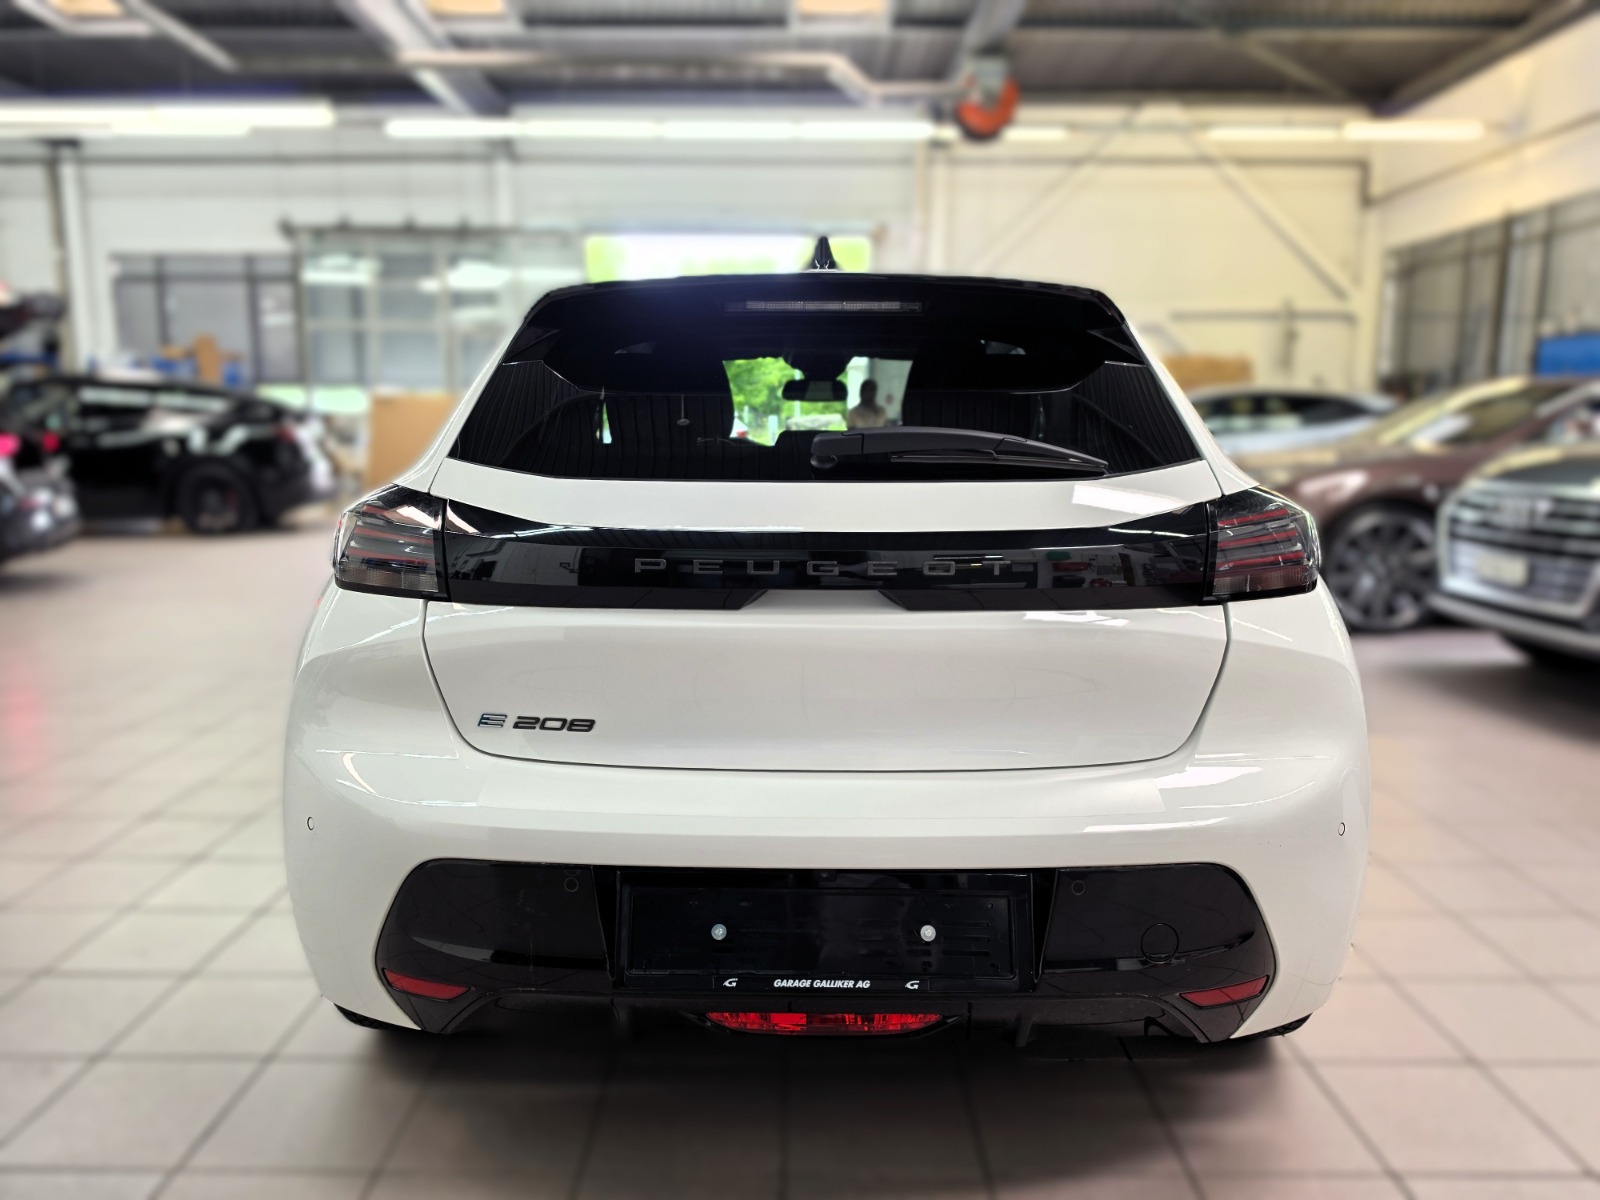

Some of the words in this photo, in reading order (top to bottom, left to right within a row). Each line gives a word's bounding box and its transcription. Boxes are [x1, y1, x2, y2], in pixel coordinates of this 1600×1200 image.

[634, 558, 1011, 576] PEUGEOT
[512, 716, 596, 732] 208
[773, 979, 811, 988] GARAGE
[813, 980, 854, 988] GALLIKER
[856, 980, 871, 988] AG
